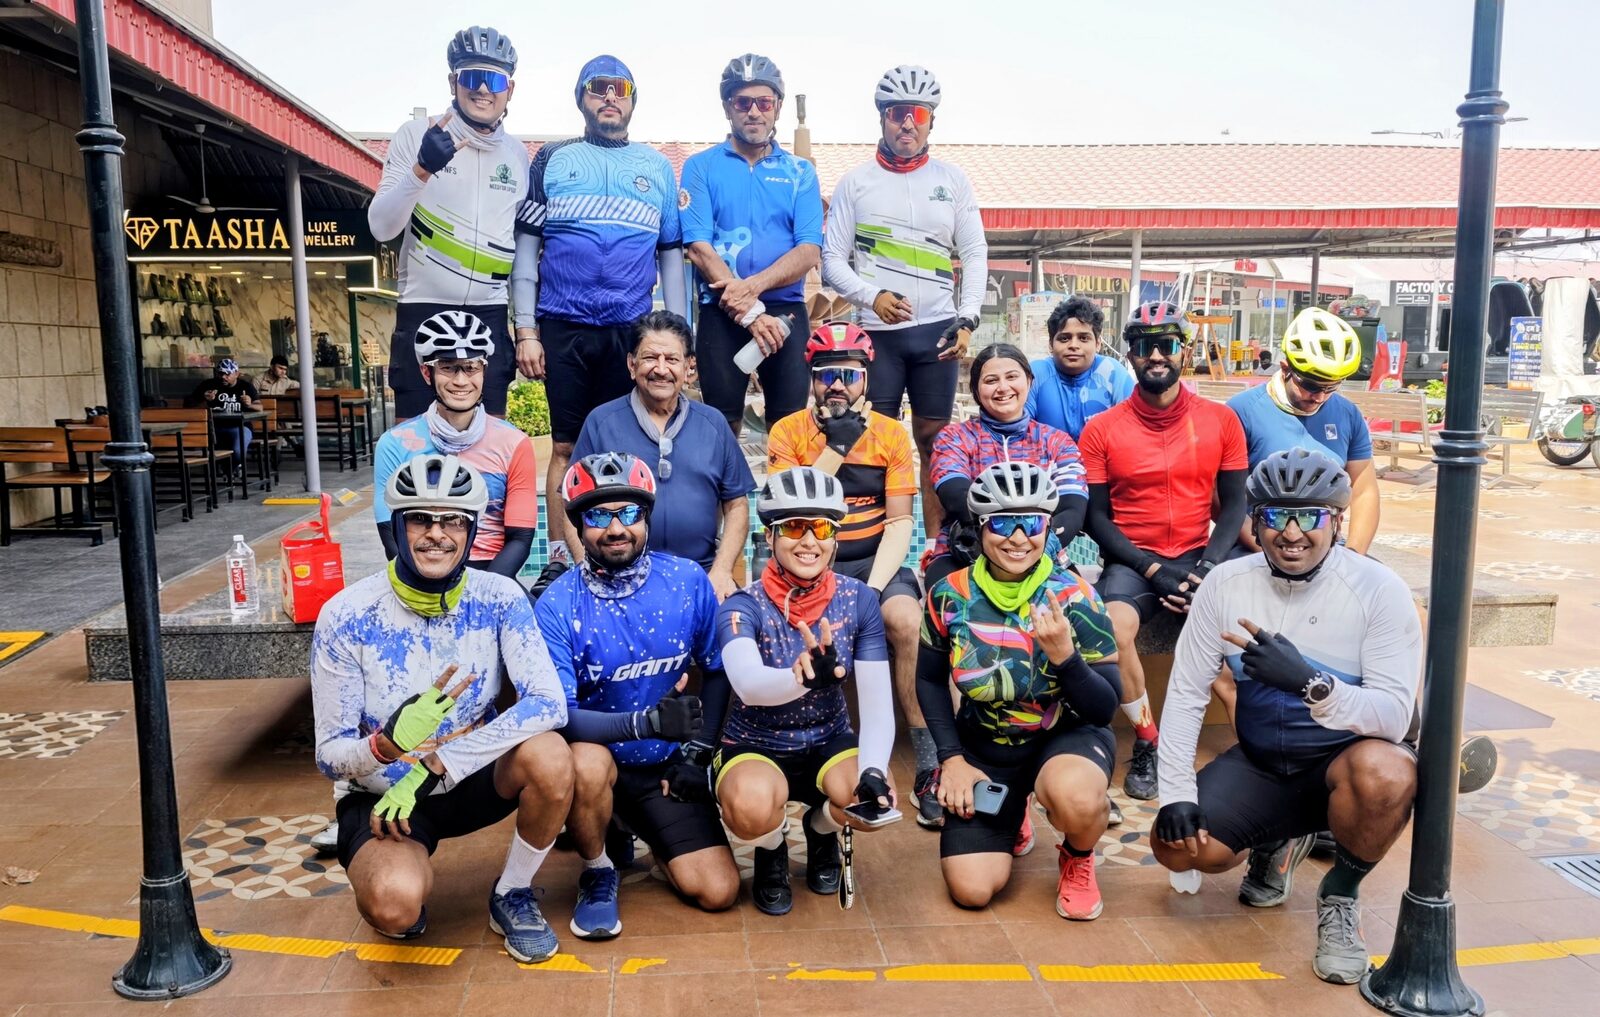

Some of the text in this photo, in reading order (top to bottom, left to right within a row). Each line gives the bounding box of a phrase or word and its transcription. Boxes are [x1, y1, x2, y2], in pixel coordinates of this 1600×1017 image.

[163, 218, 290, 249] TAASHA
[307, 221, 338, 233] LUXE
[304, 234, 356, 247] WELLERY
[1076, 275, 1130, 293] BUTTON
[610, 651, 689, 682] GIANT
